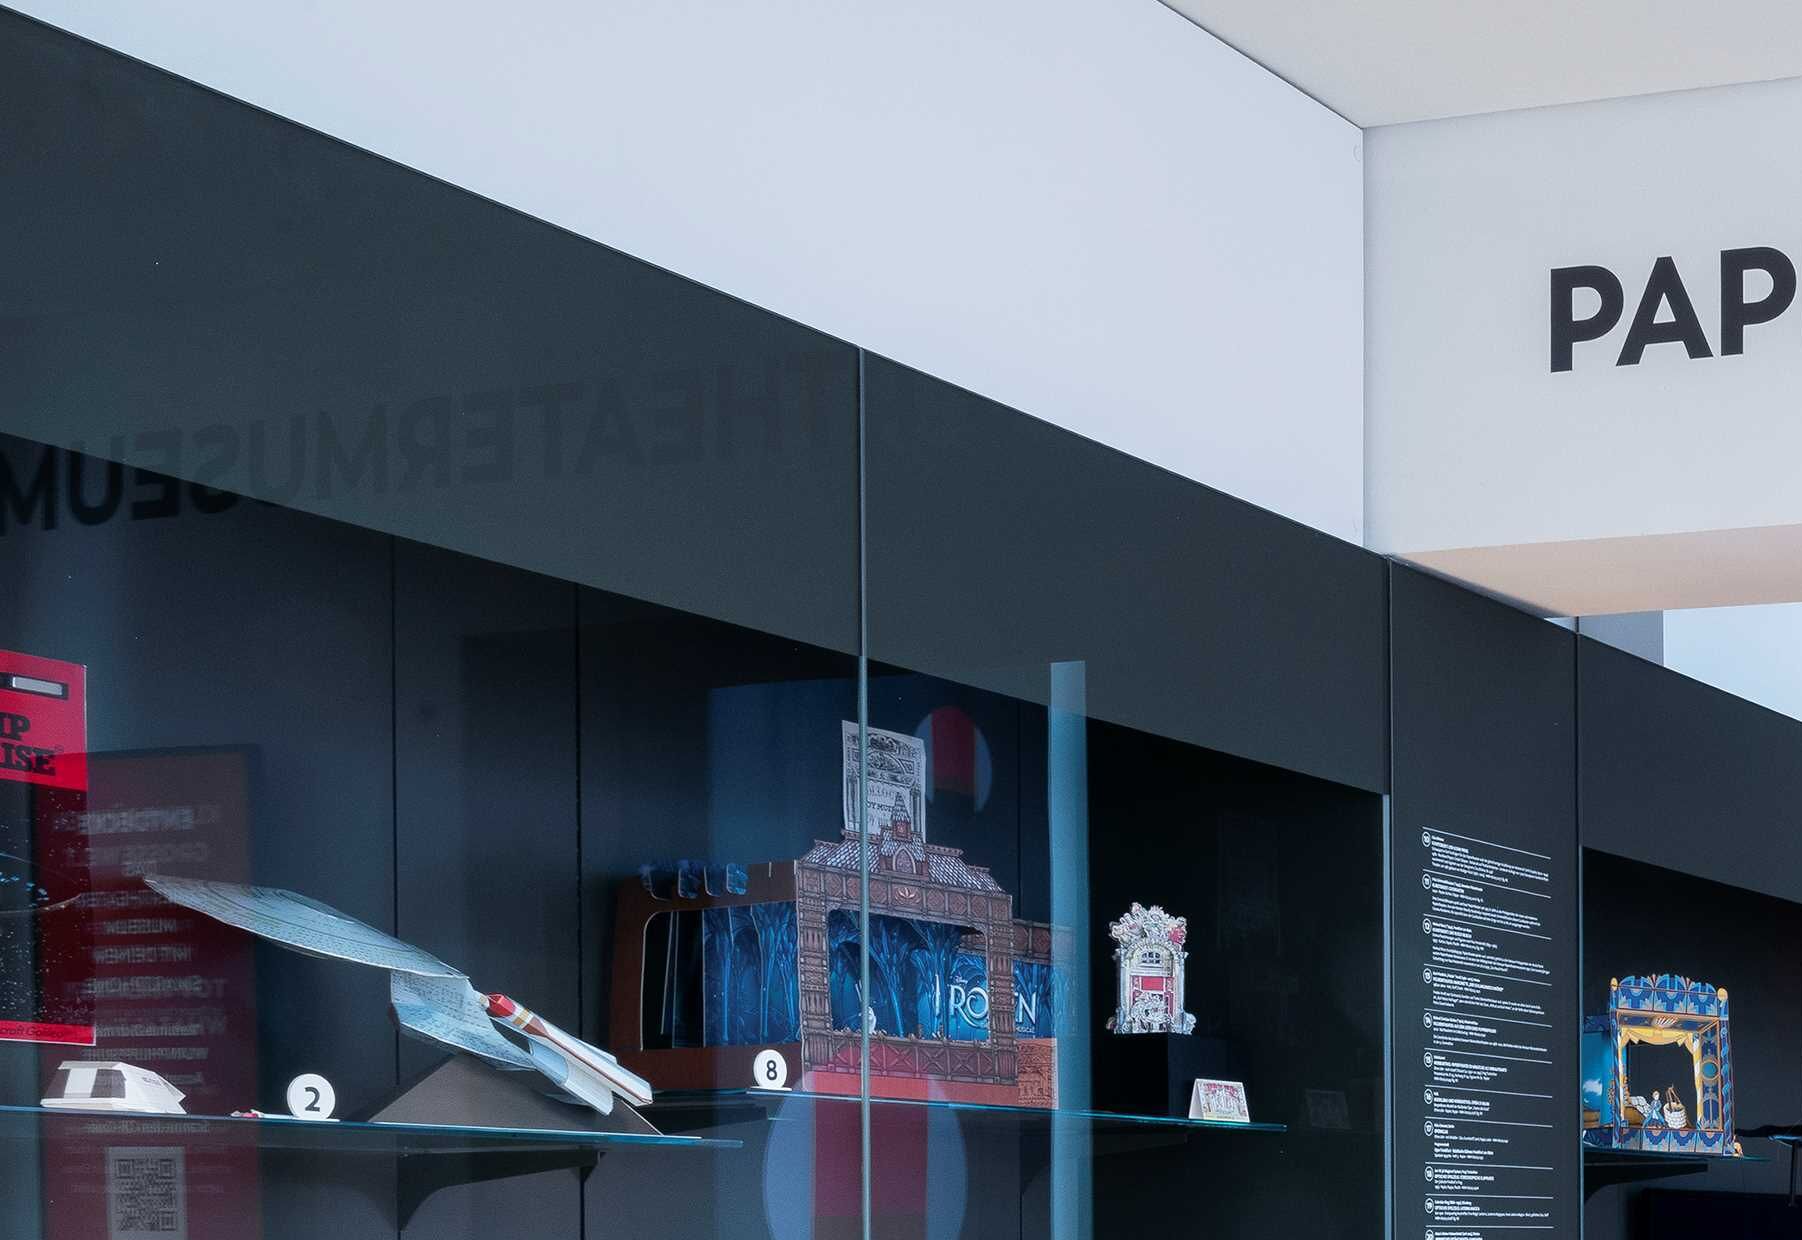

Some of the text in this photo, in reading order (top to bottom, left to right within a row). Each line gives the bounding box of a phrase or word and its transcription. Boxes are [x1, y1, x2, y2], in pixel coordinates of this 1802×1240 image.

[0, 742, 56, 776] ISE
[765, 1059, 778, 1082] 8
[304, 1087, 321, 1112] 2
